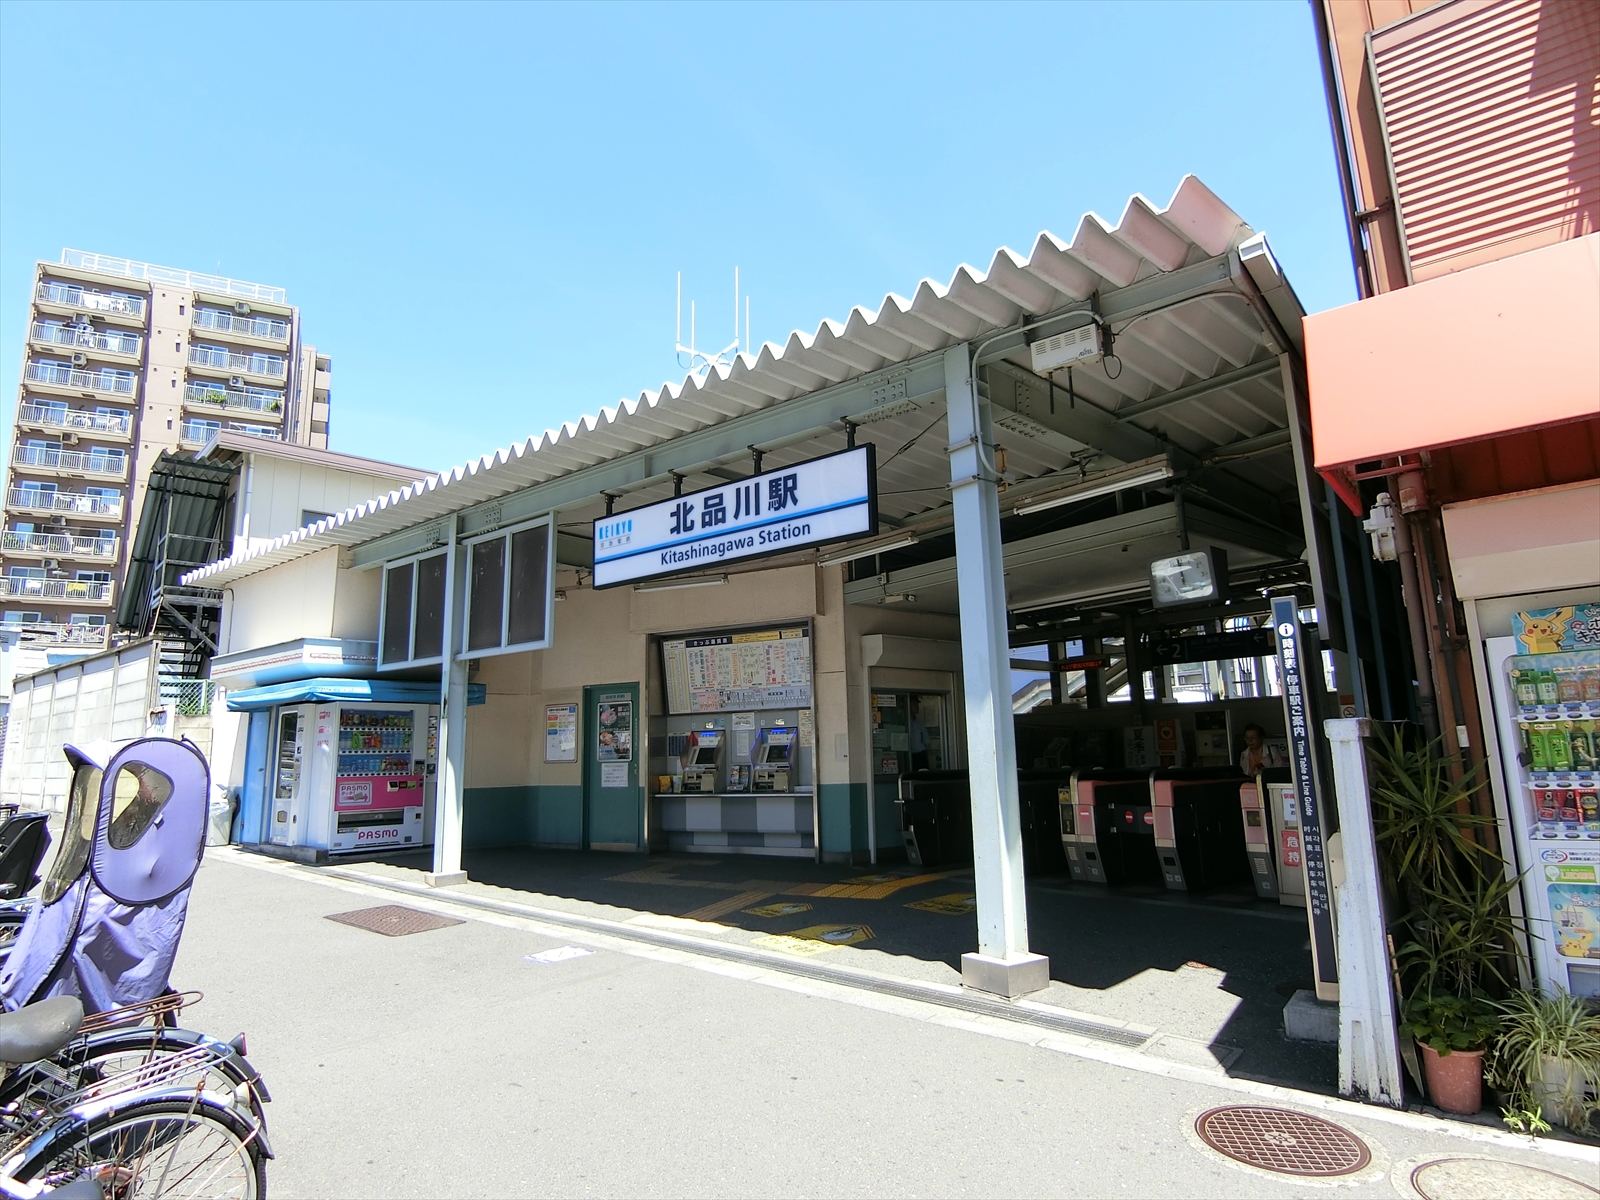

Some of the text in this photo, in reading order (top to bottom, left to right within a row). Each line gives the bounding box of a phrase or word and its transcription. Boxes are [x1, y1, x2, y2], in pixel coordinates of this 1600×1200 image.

[669, 473, 799, 535] 北品川駅
[599, 519, 632, 540] KEIKYU
[660, 523, 811, 566] Kitashinagawa Station
[1171, 643, 1182, 659] 2
[1297, 740, 1305, 756] Time
[1299, 757, 1308, 775] Table
[1302, 781, 1311, 796] Line
[1304, 796, 1313, 817] Guide
[358, 829, 399, 840] PASMO
